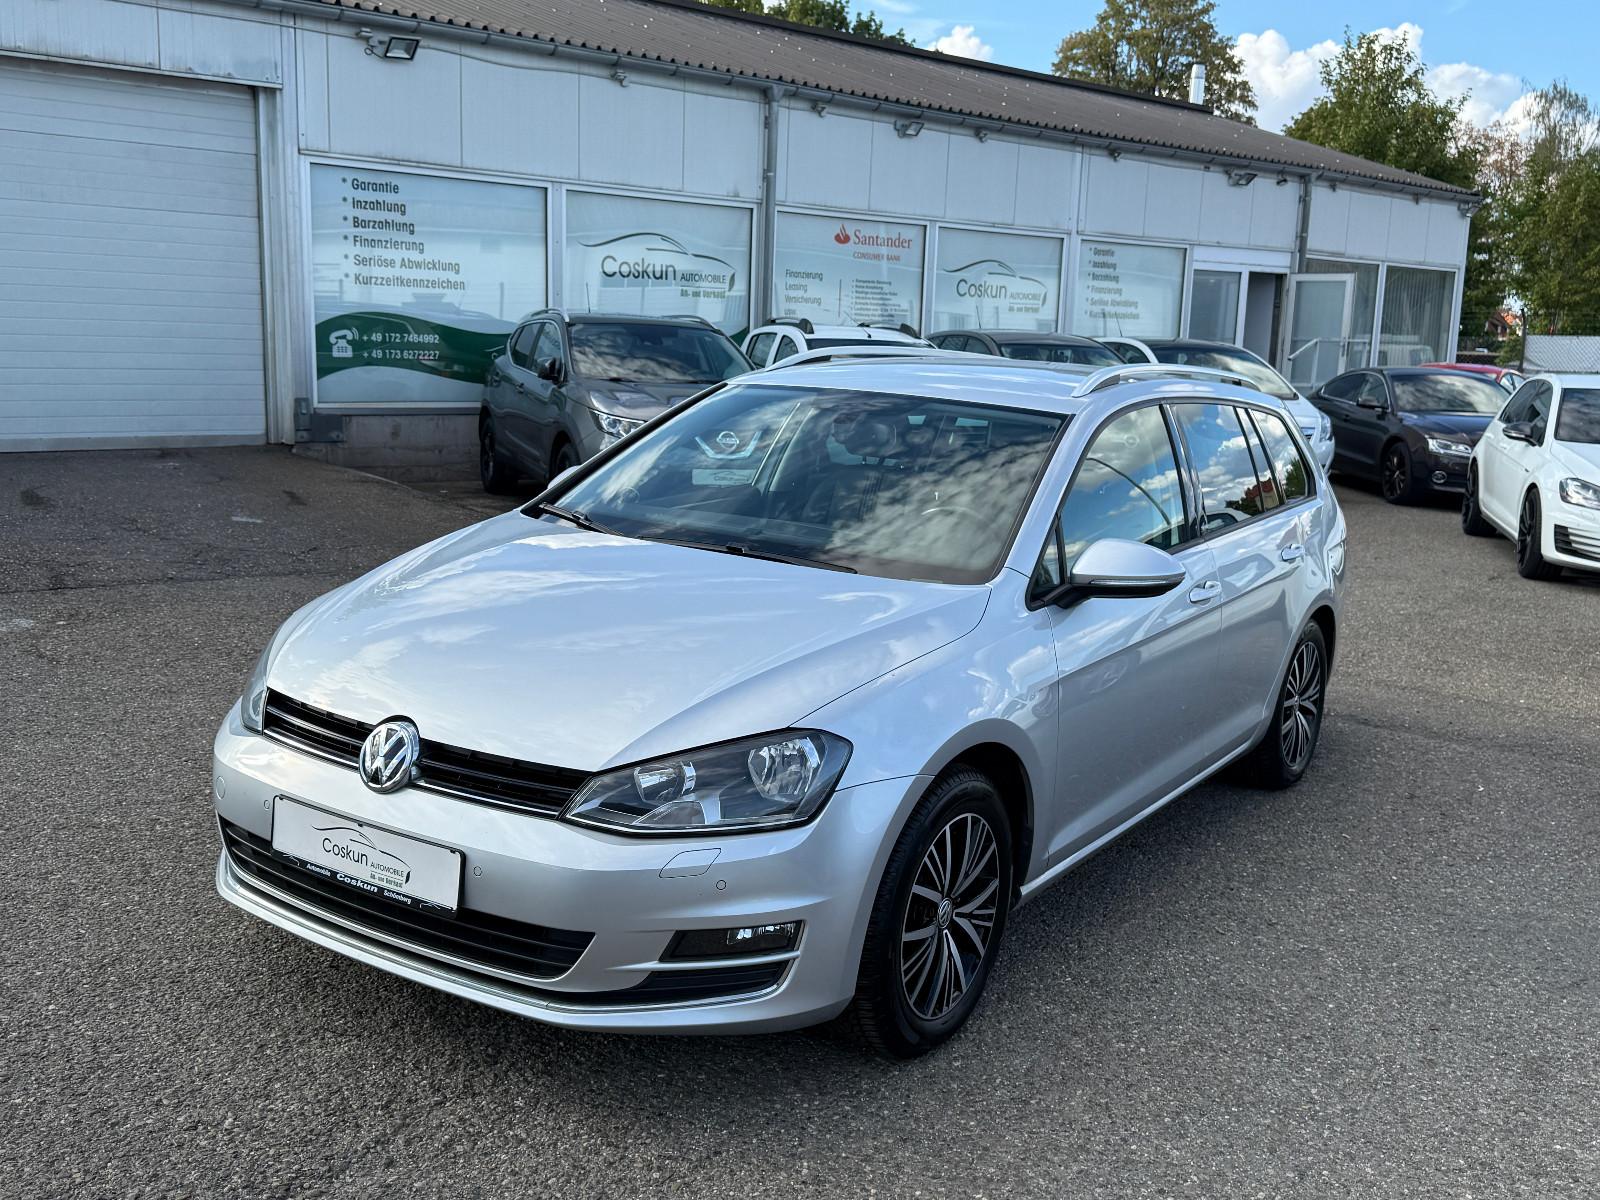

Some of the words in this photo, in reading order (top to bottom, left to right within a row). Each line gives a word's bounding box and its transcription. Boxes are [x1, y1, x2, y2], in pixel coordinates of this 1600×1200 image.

[351, 178, 399, 194] Garantie
[352, 197, 406, 216] Inzahlung
[352, 216, 415, 235] Barzahlung
[353, 235, 425, 254] Finanzierung
[853, 229, 913, 249] Santander
[353, 254, 396, 268] Seriöse
[399, 258, 460, 275] Abwicklung
[601, 255, 677, 281] Coskun
[354, 273, 465, 290] Kurzzeitkennzeichen
[680, 272, 726, 284] AUTOMOBILE
[785, 269, 824, 281] Finanzierung
[785, 281, 808, 293] Leasing
[956, 278, 1007, 299] Coskun
[784, 294, 822, 306] Versicherung
[370, 333, 383, 342] 49
[385, 333, 401, 342] 172
[371, 349, 383, 358] 49
[385, 349, 401, 359] 173
[403, 350, 440, 359] 6272227
[322, 837, 369, 867] Coskun
[370, 861, 404, 878] AUTOMOBILE
[336, 873, 378, 893] Coskun
